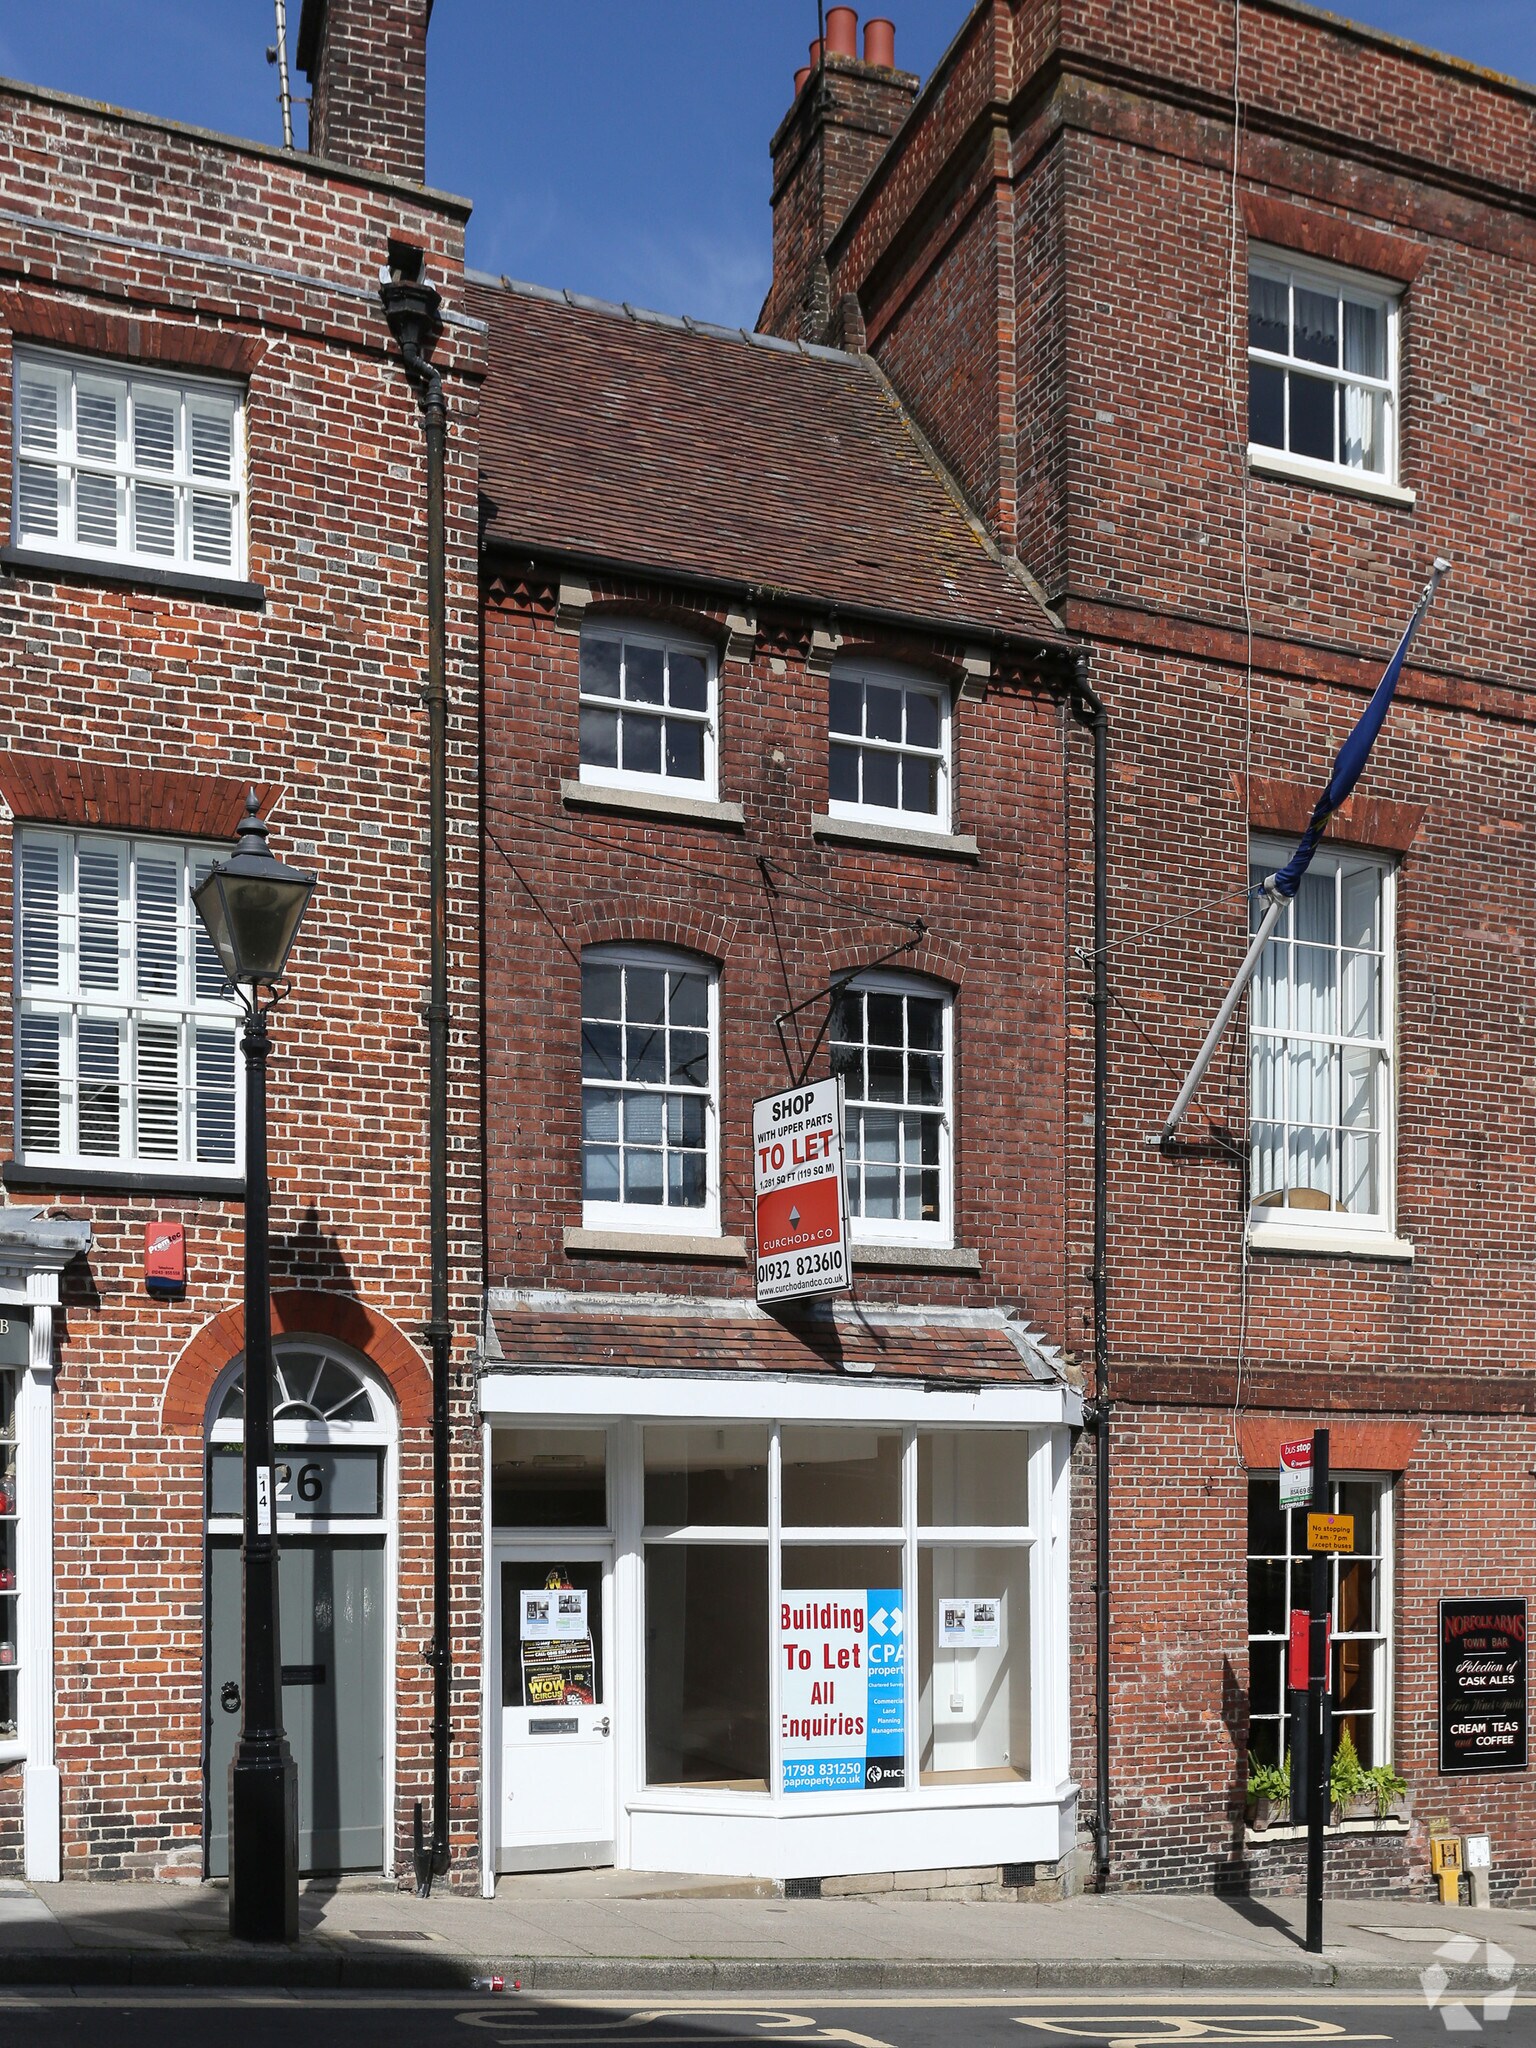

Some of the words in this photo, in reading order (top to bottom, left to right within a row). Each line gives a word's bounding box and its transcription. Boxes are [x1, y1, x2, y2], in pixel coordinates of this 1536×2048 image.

[772, 1092, 815, 1122] SHOP
[758, 1129, 776, 1144] WITH
[778, 1121, 804, 1137] UPPER
[805, 1113, 833, 1129] PARTS
[759, 1143, 785, 1174] TO
[792, 1129, 834, 1165] LET
[776, 1175, 786, 1186] SQ
[787, 1172, 796, 1182] FT
[797, 1168, 811, 1181] (119
[813, 1165, 824, 1176] SQ
[825, 1163, 835, 1173] M)
[758, 1260, 791, 1284] 01932
[796, 1250, 843, 1276] 823610
[759, 1273, 844, 1296] www.curchodandco.co.uk
[1285, 1445, 1296, 1455] bus
[1296, 1443, 1311, 1453] stop
[275, 1463, 323, 1502] 26
[781, 1603, 864, 1634] Building
[1444, 1614, 1493, 1643] NORFOLK
[1494, 1614, 1525, 1642] ARMS
[1463, 1638, 1487, 1648] TOWN
[1491, 1637, 1508, 1648] BAR
[783, 1644, 811, 1670] To
[823, 1643, 861, 1670] Let
[1456, 1660, 1503, 1673] Selection
[1506, 1660, 1518, 1673] of
[528, 1679, 566, 1694] WOW
[1458, 1676, 1487, 1686] CASK
[1489, 1675, 1515, 1684] ALES
[534, 1691, 562, 1700] CIRCUS
[811, 1682, 834, 1705] All
[877, 1717, 901, 1725] Planning
[1450, 1723, 1487, 1734] CREAM
[1492, 1722, 1519, 1732] TEAS
[1476, 1735, 1514, 1746] COFFEE
[819, 1763, 861, 1776] 831250
